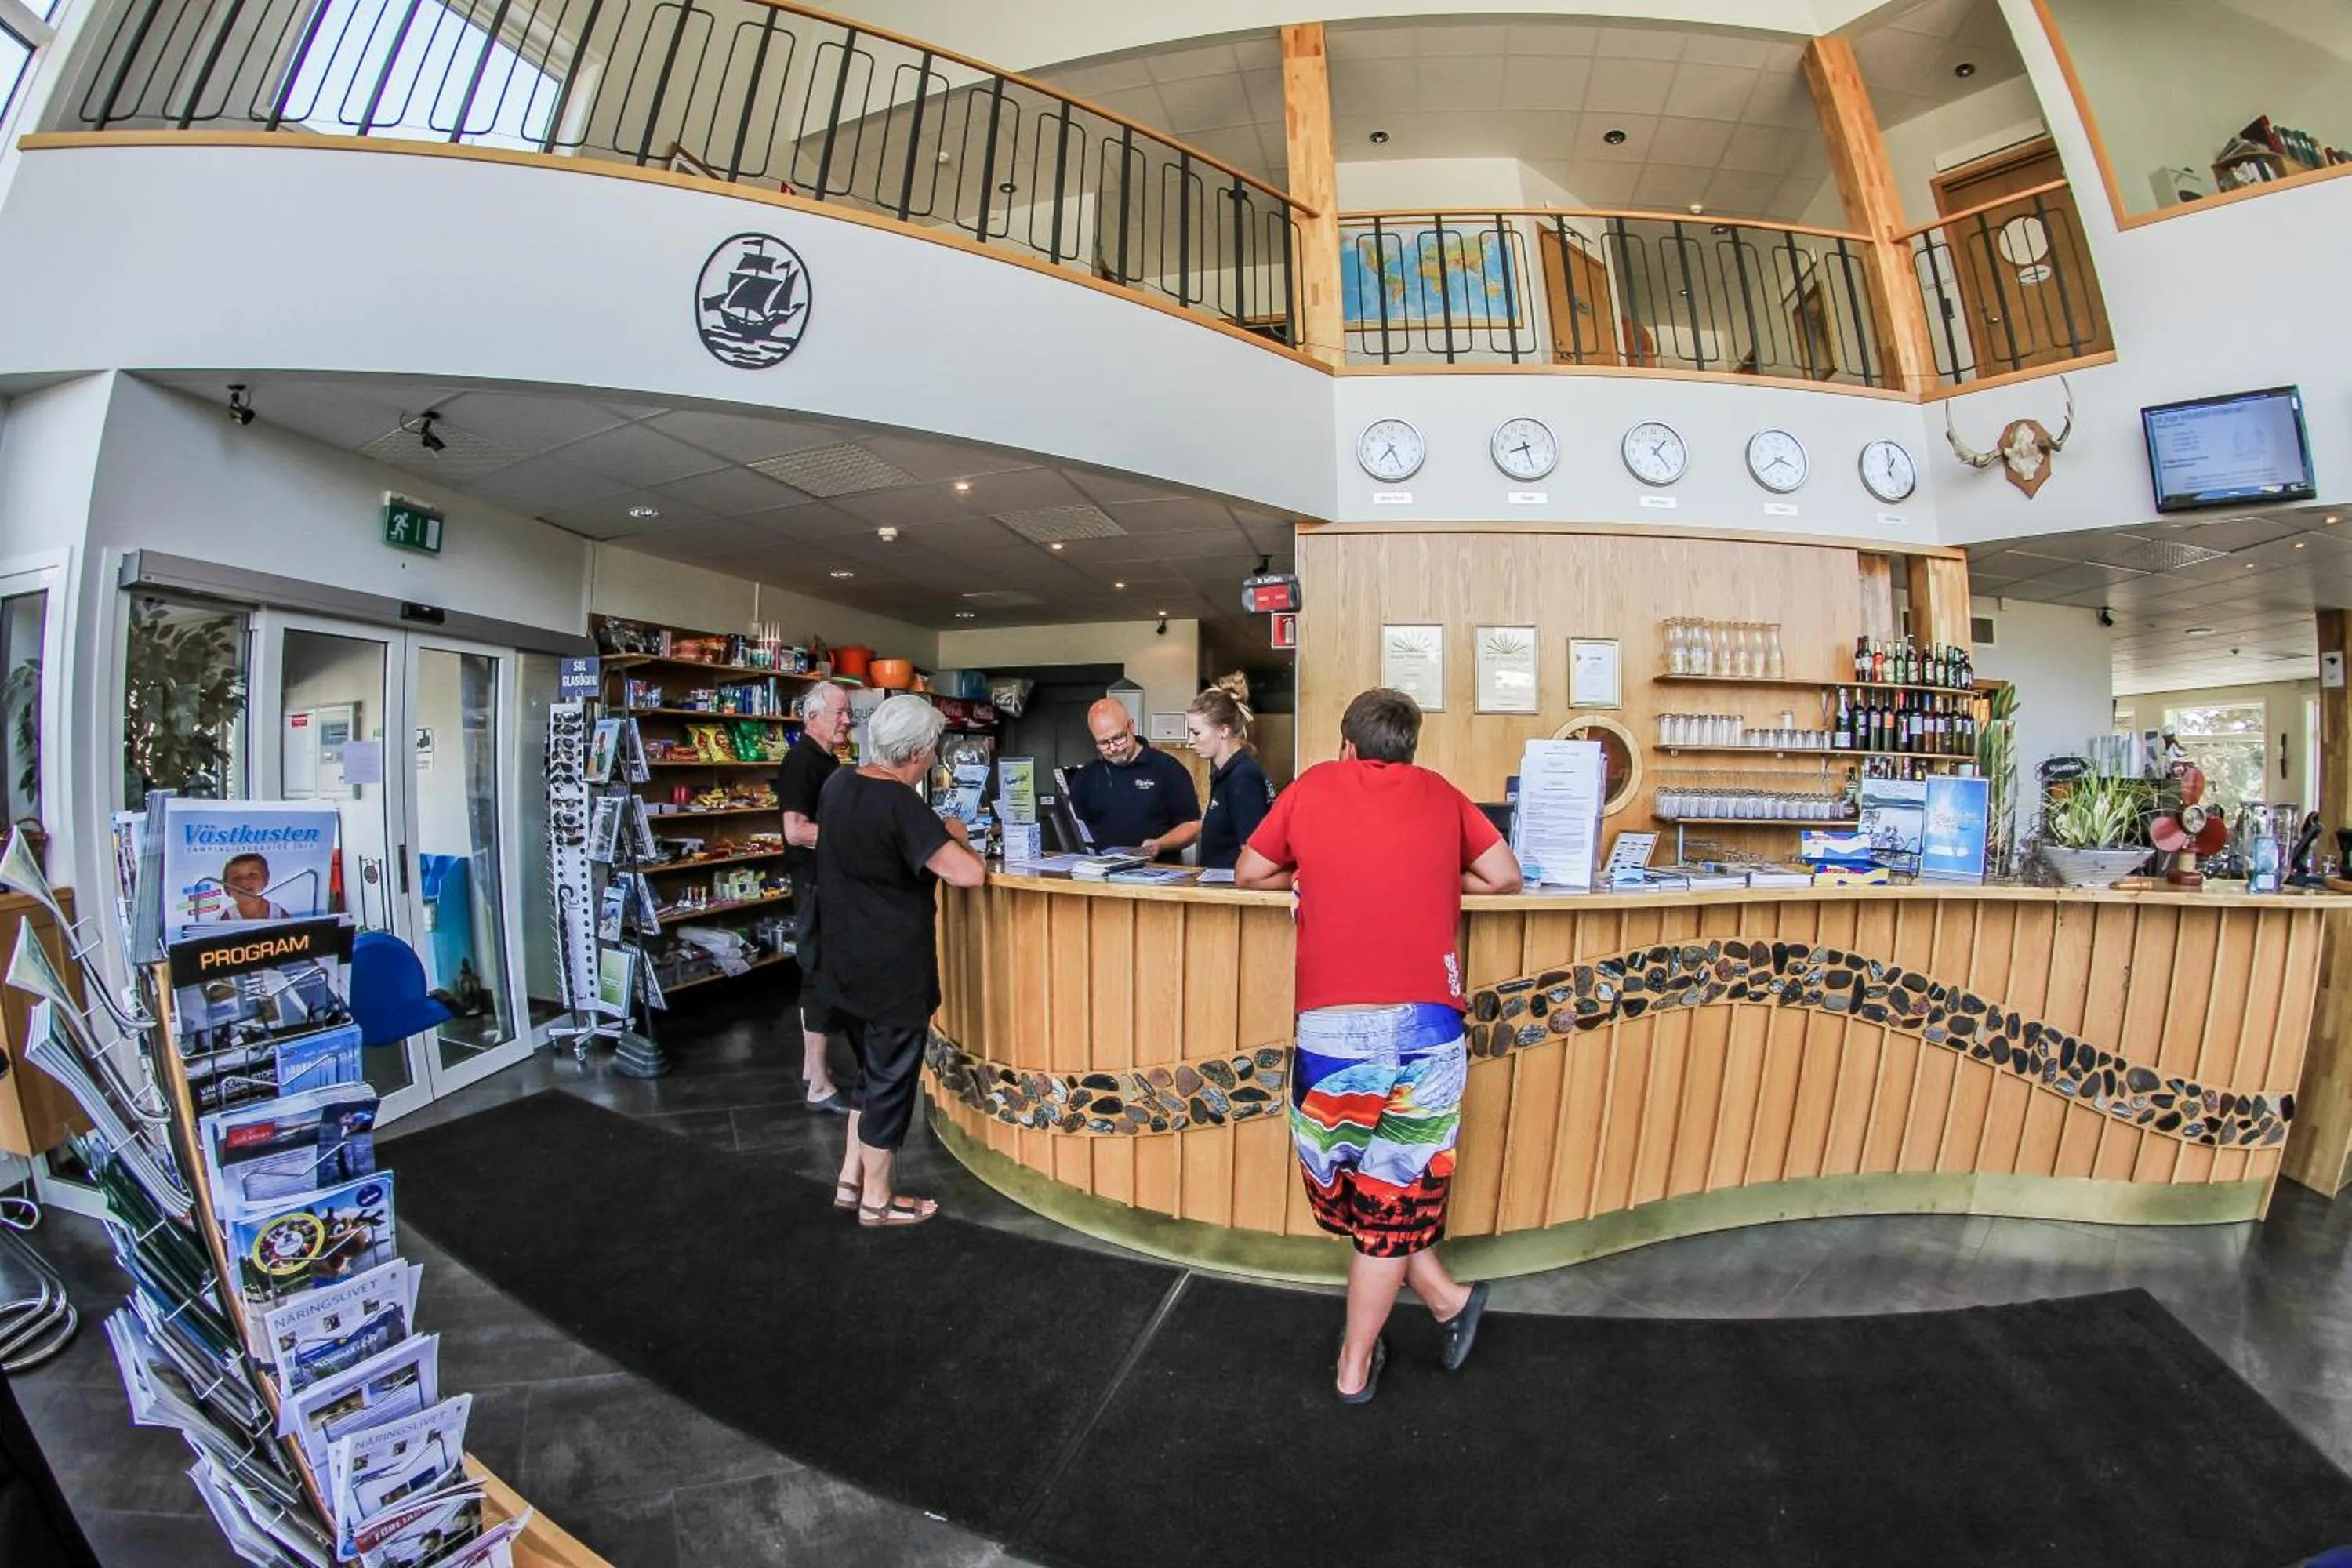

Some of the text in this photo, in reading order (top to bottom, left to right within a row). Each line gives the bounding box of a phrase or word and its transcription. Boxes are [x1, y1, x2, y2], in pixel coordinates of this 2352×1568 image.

[184, 823, 321, 845] Västkusten
[201, 934, 310, 970] PROGRAM
[274, 1279, 378, 1329] NÄRINGSLIVET
